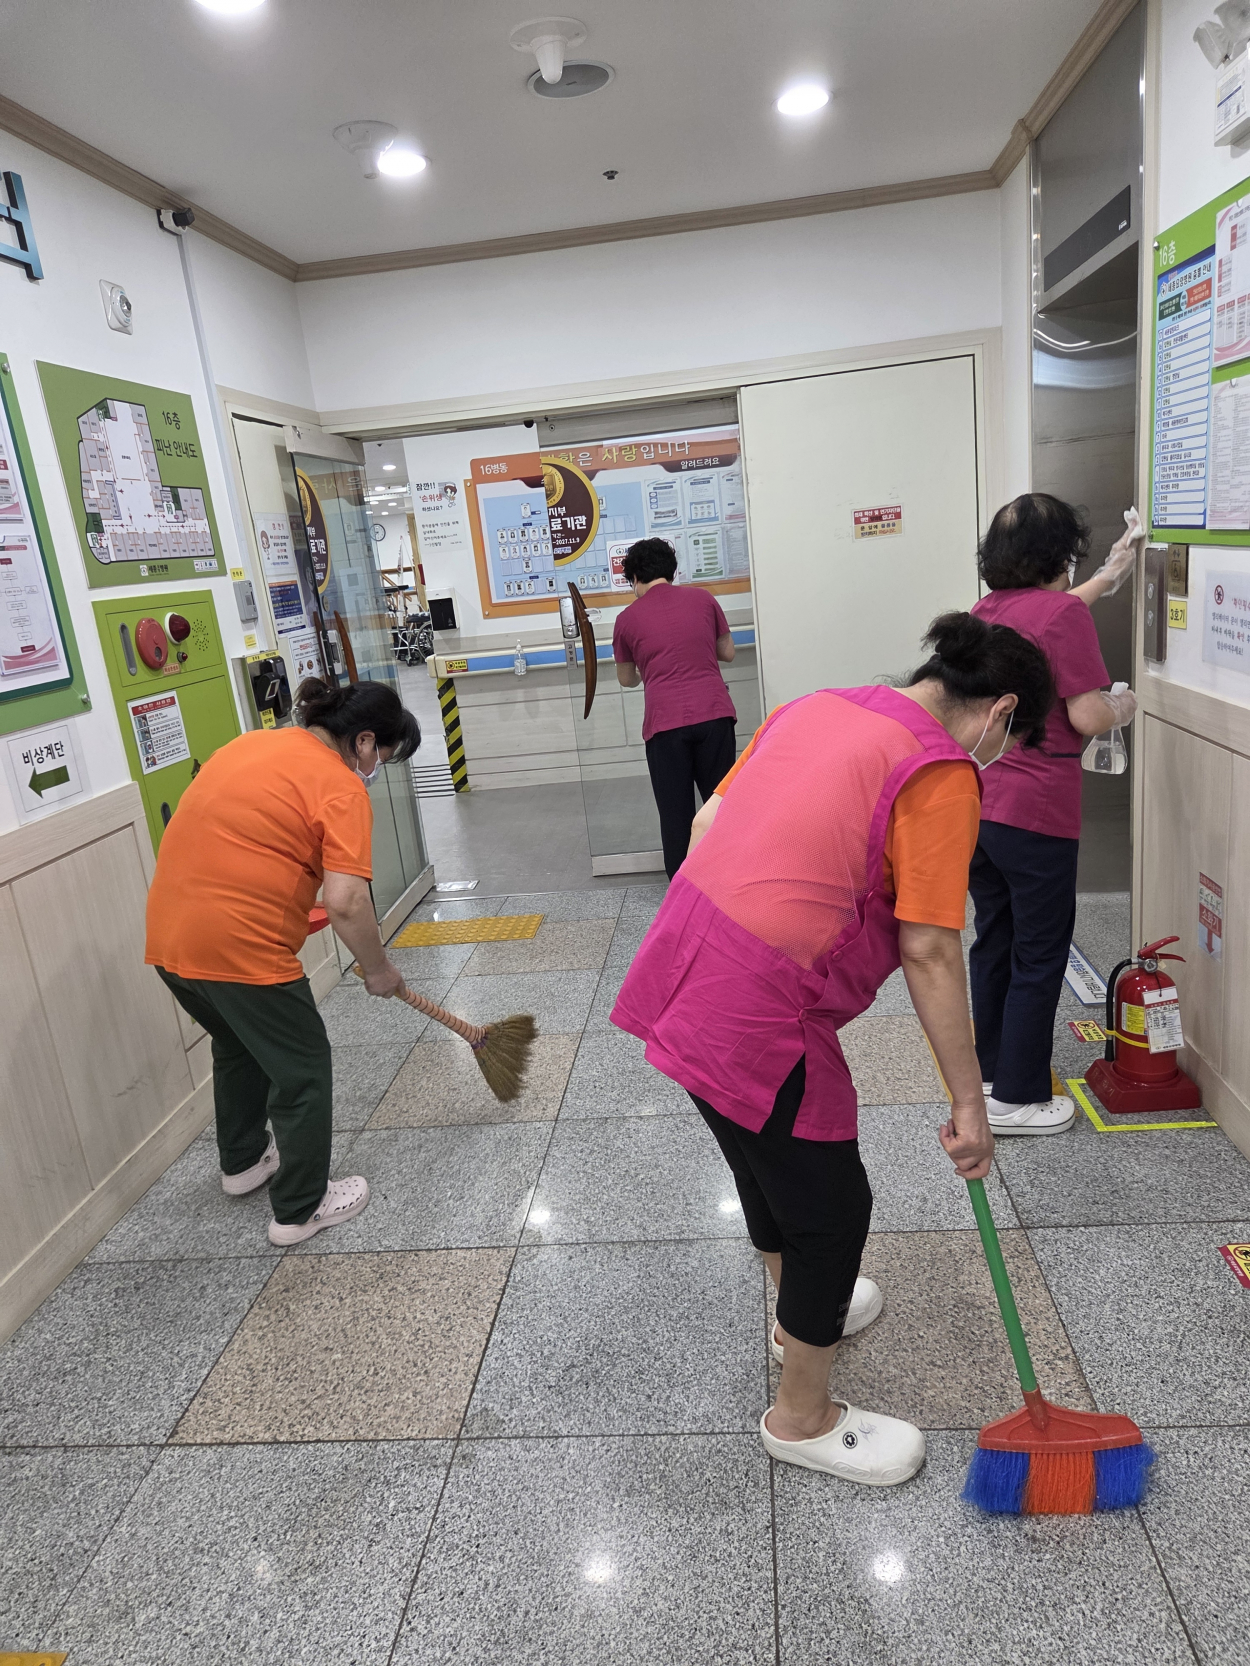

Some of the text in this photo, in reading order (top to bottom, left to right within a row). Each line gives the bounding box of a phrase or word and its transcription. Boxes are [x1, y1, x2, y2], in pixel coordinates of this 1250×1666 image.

[1159, 240, 1176, 267] 16층
[162, 411, 181, 430] 16층
[155, 438, 198, 459] 피난 안내도
[602, 441, 690, 463] 사랑입니다
[480, 462, 508, 475] 16병동
[680, 458, 720, 470] 알려드려요
[416, 482, 435, 491] 잠깐!!
[550, 515, 587, 531] 료기관
[1170, 608, 1185, 623] 3호기
[22, 741, 64, 766] 비상계단
